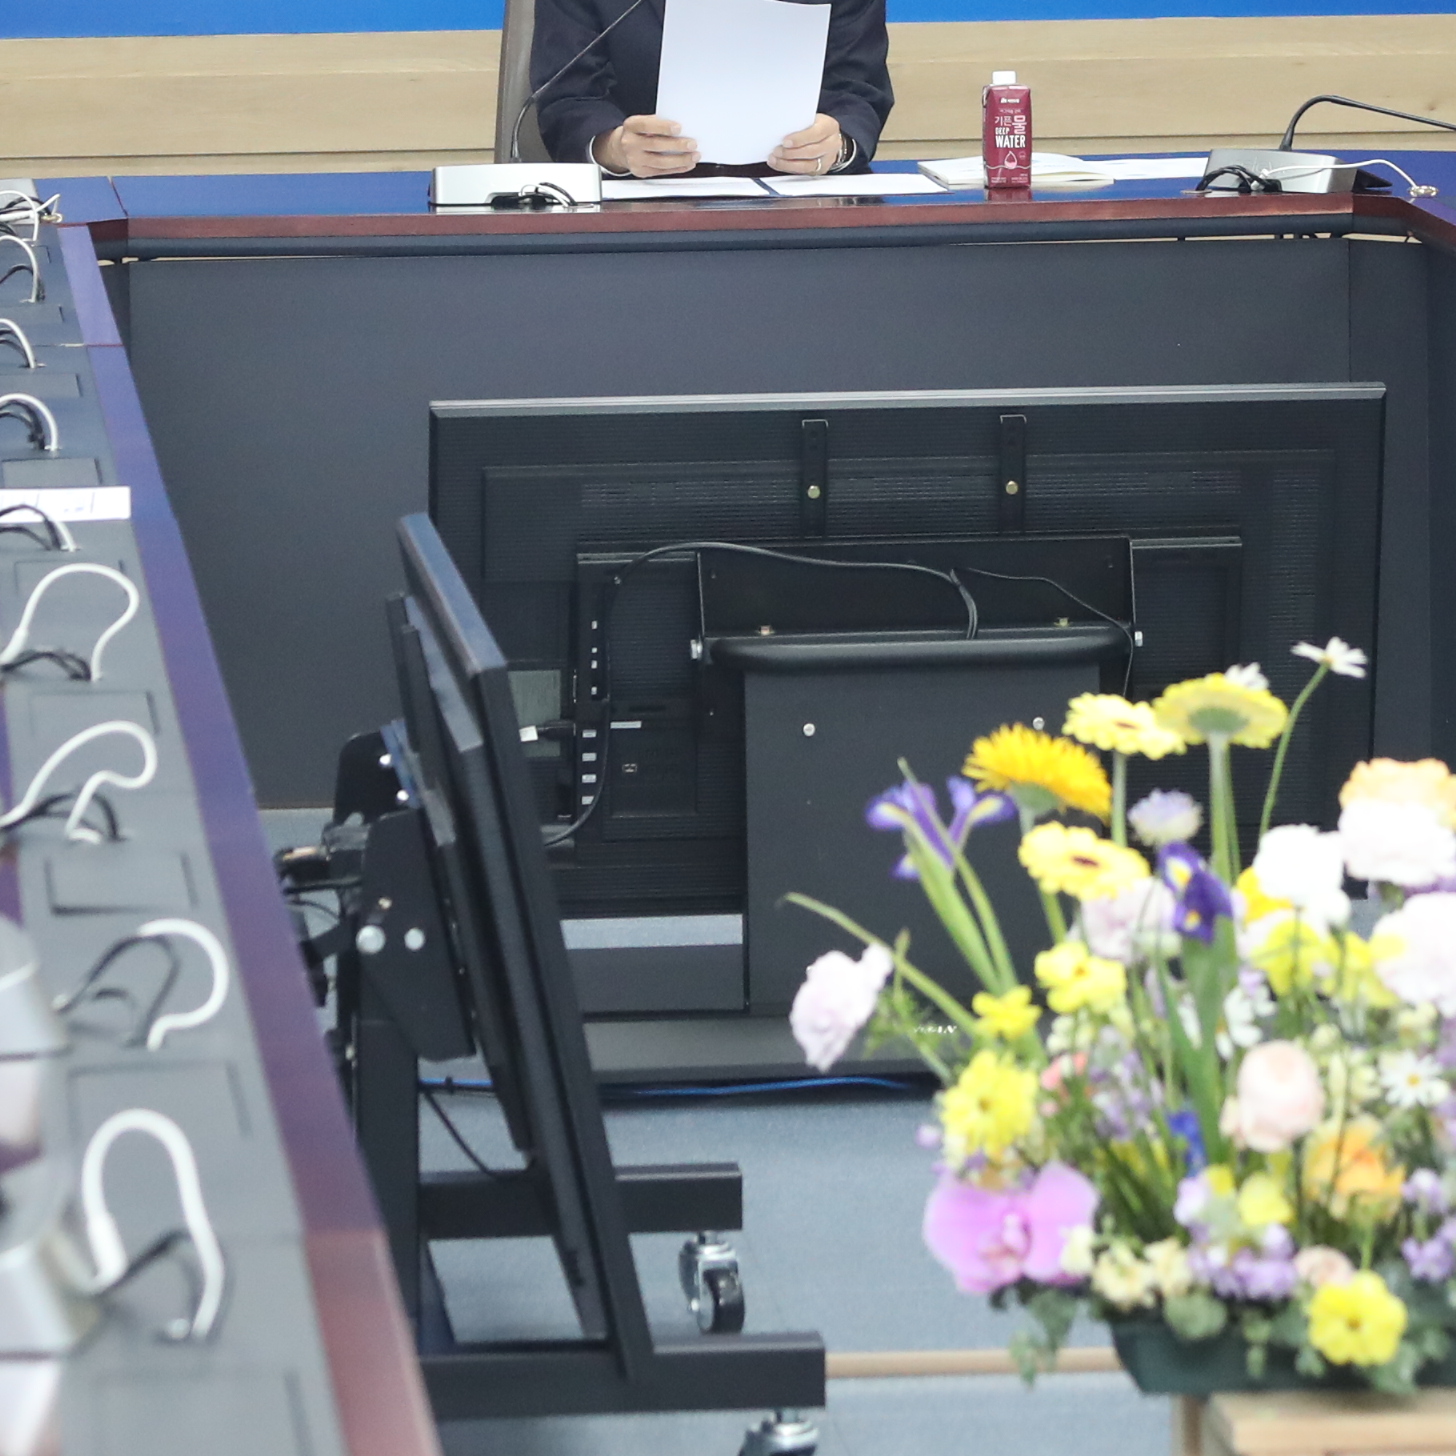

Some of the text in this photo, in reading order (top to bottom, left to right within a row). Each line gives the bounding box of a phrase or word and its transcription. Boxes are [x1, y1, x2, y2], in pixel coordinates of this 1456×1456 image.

[995, 127, 1010, 135] DEEP
[1012, 114, 1027, 135] 물
[995, 135, 1026, 149] WATER
